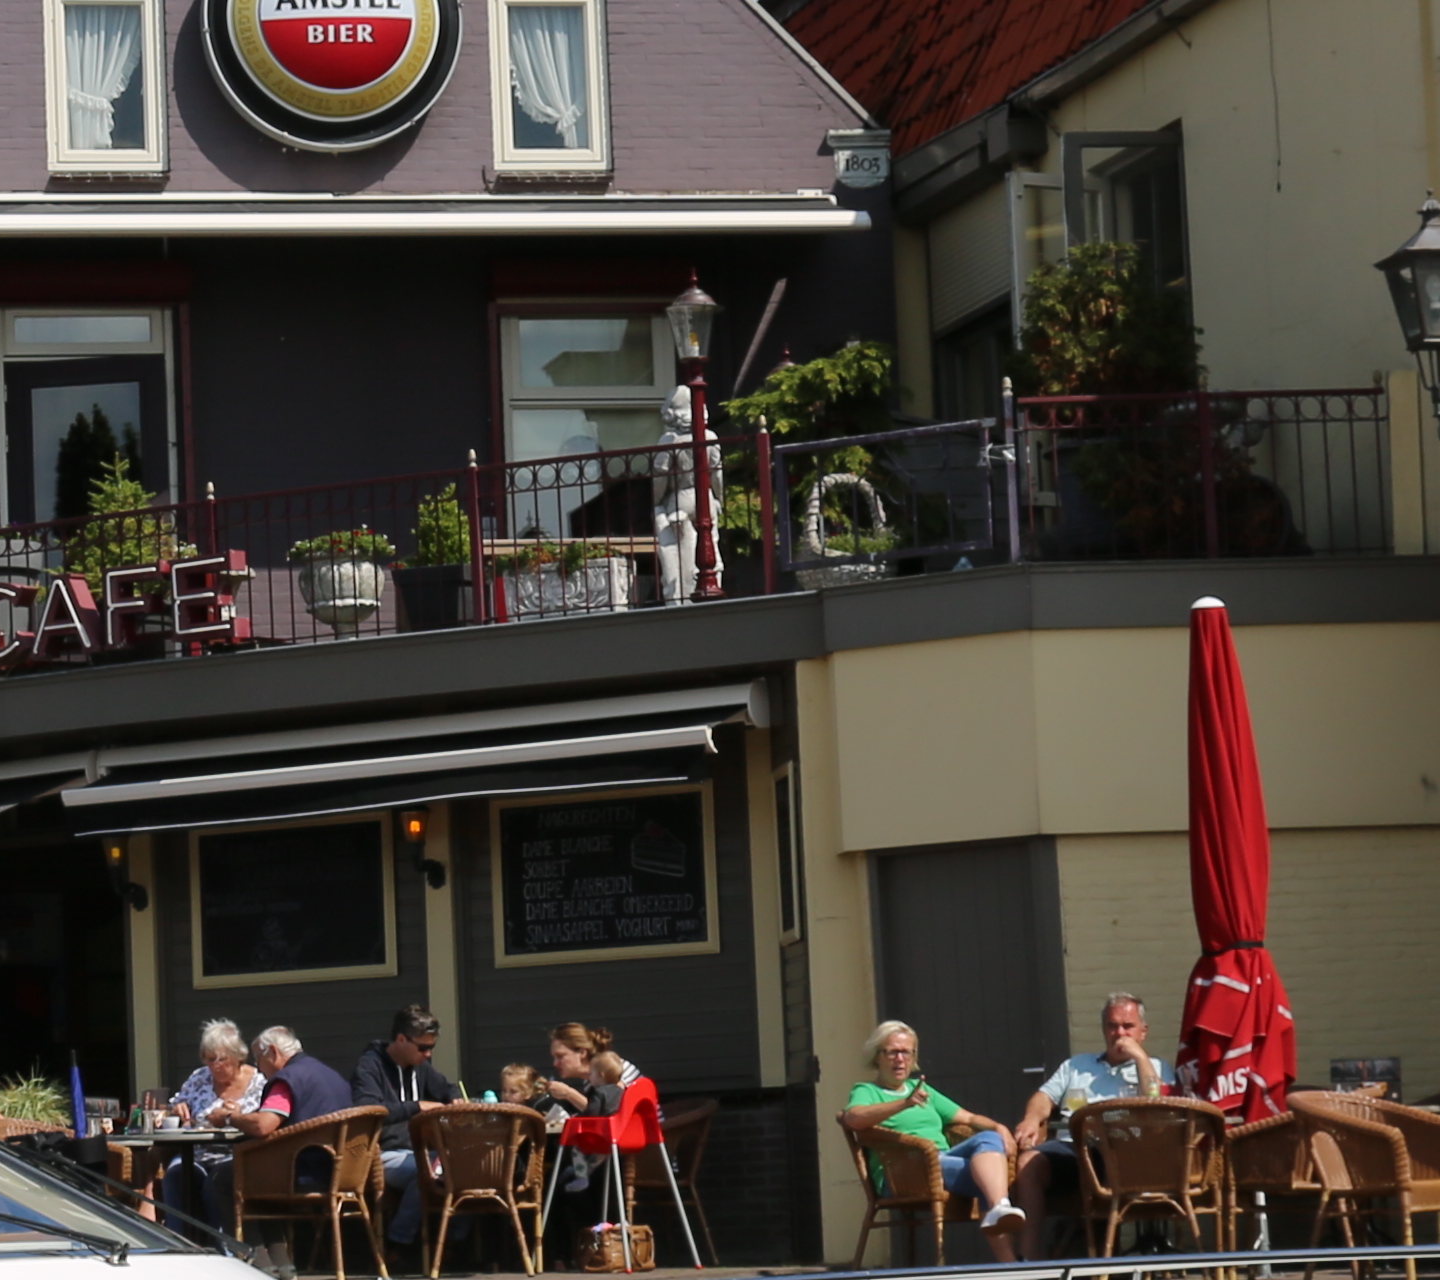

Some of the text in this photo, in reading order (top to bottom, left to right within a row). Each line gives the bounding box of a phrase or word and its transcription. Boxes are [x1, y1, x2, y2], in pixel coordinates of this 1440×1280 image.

[307, 24, 375, 44] BIER
[845, 155, 880, 173] 1803
[523, 835, 613, 857] DAME BLANCHE
[523, 859, 570, 878] SORBET
[523, 881, 564, 900] COUPE
[526, 902, 559, 920] DAME
[563, 898, 616, 917] BLANCHE
[615, 917, 671, 937] YOGHURT
